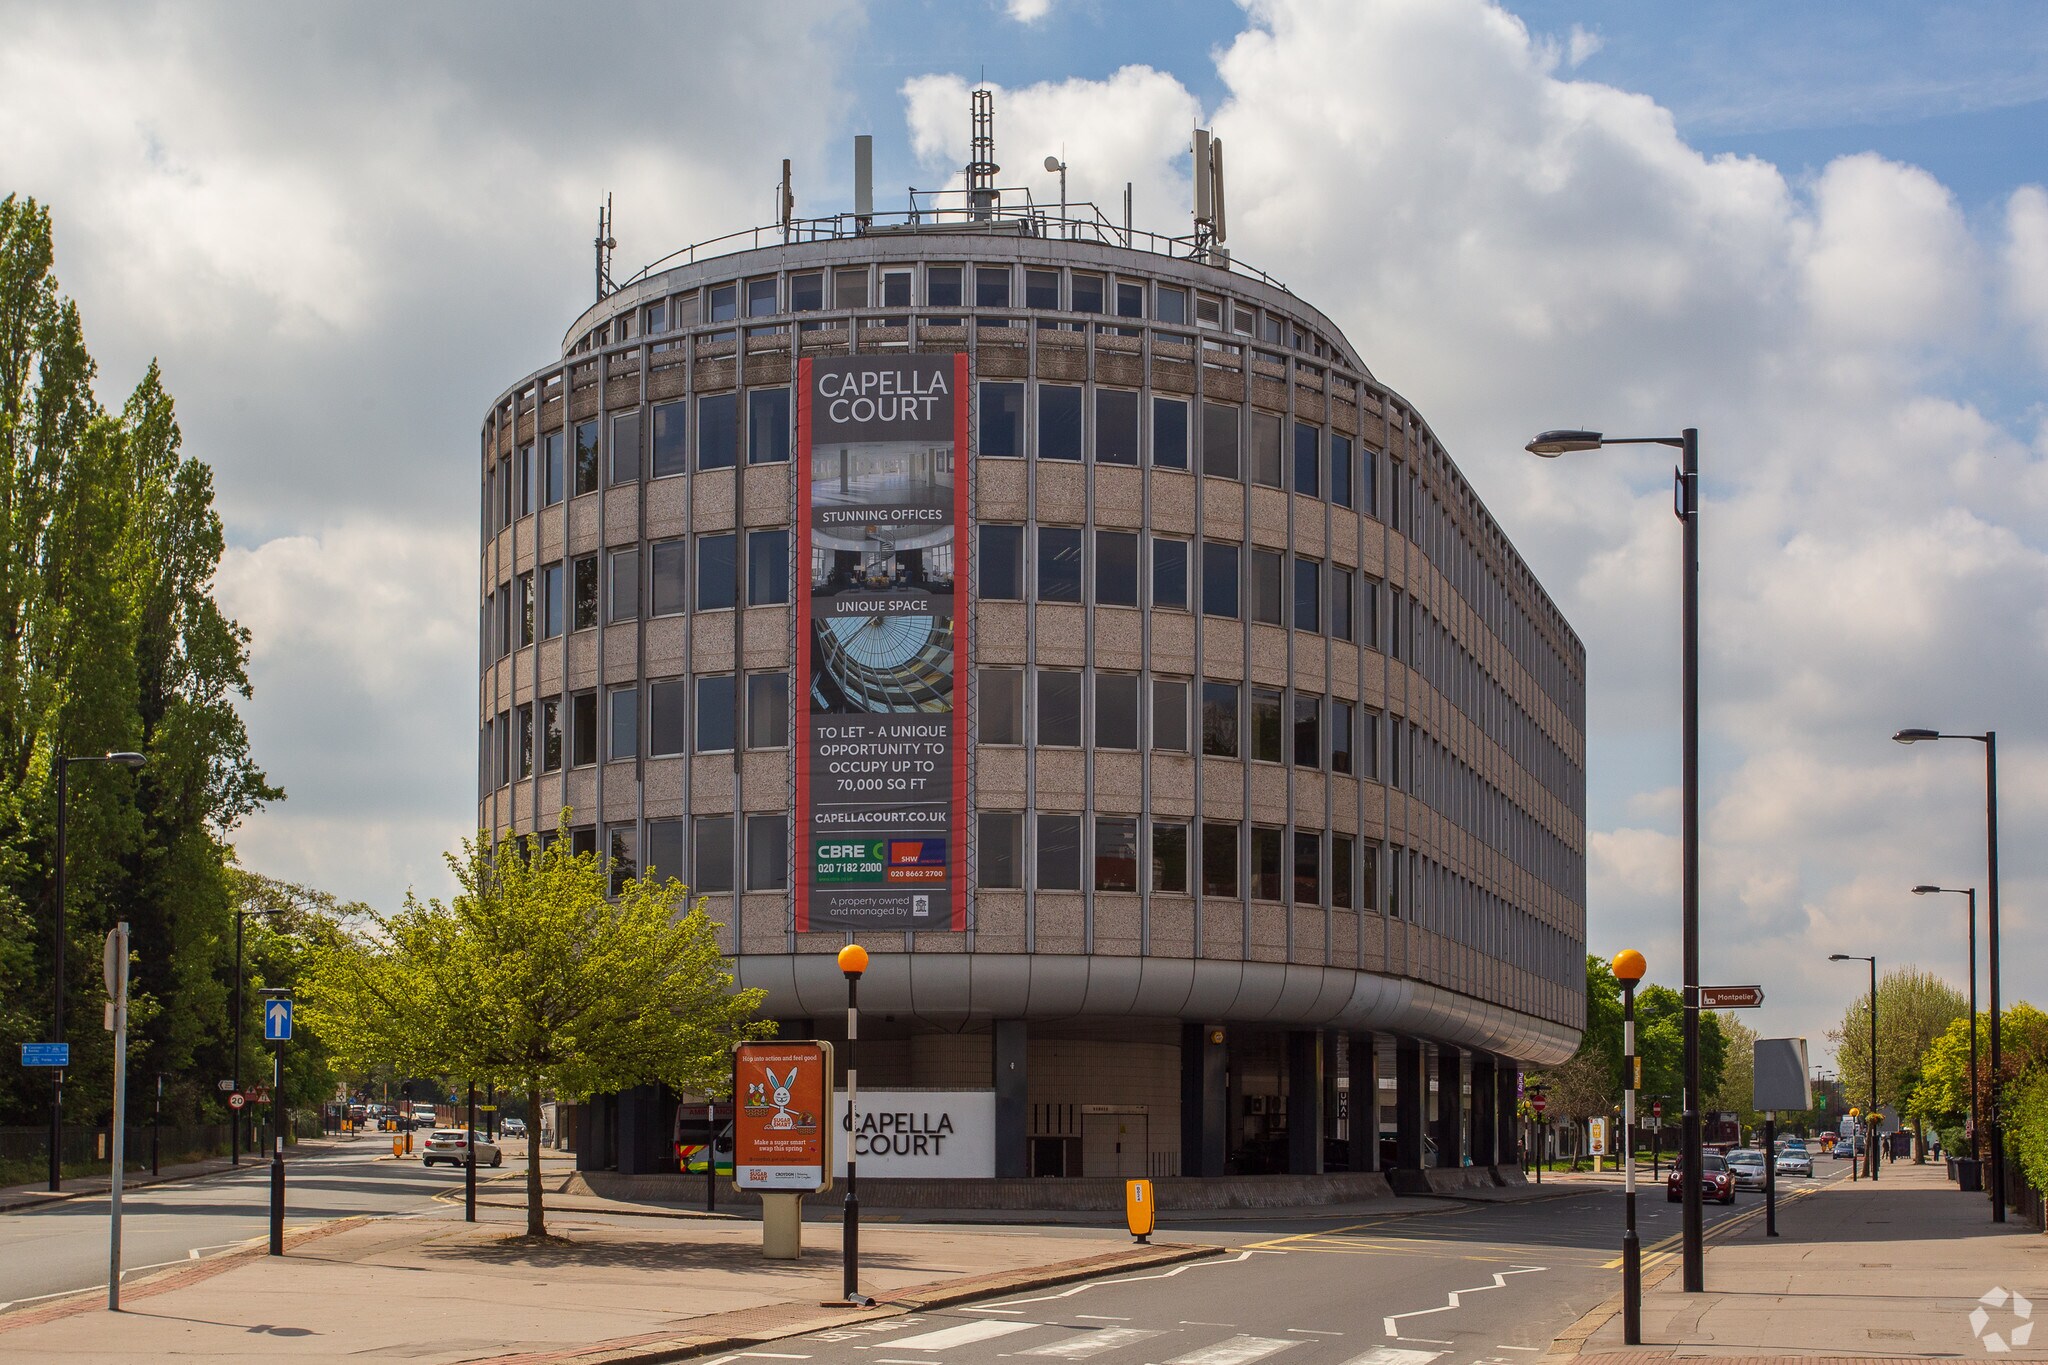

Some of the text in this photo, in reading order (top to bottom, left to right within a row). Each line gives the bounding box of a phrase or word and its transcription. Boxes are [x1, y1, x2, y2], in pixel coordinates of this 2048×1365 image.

[818, 370, 948, 397] CAPELLA
[829, 397, 938, 423] COURT
[822, 509, 942, 523] STUNNING OFFICES
[836, 600, 928, 612] UNIQUE SPACE
[818, 727, 837, 738] TO
[841, 727, 865, 738] LET
[878, 726, 887, 737] A
[891, 725, 947, 738] UNIQUE
[820, 743, 945, 756] OPPORTUNITY TO
[829, 760, 934, 773] OCCUPY UP TO
[837, 778, 926, 792] 70,000 SQ FT
[815, 812, 946, 824] CAPELLACOURT.CO.UK
[818, 845, 865, 858] CBRE
[818, 862, 882, 873] 020 7182 2000
[838, 897, 878, 907] property
[879, 897, 910, 905] owned
[830, 907, 908, 917] and managed by
[1717, 993, 1754, 1001] Montpelier
[842, 1112, 954, 1134] CAPELLA
[855, 1134, 946, 1156] COURT
